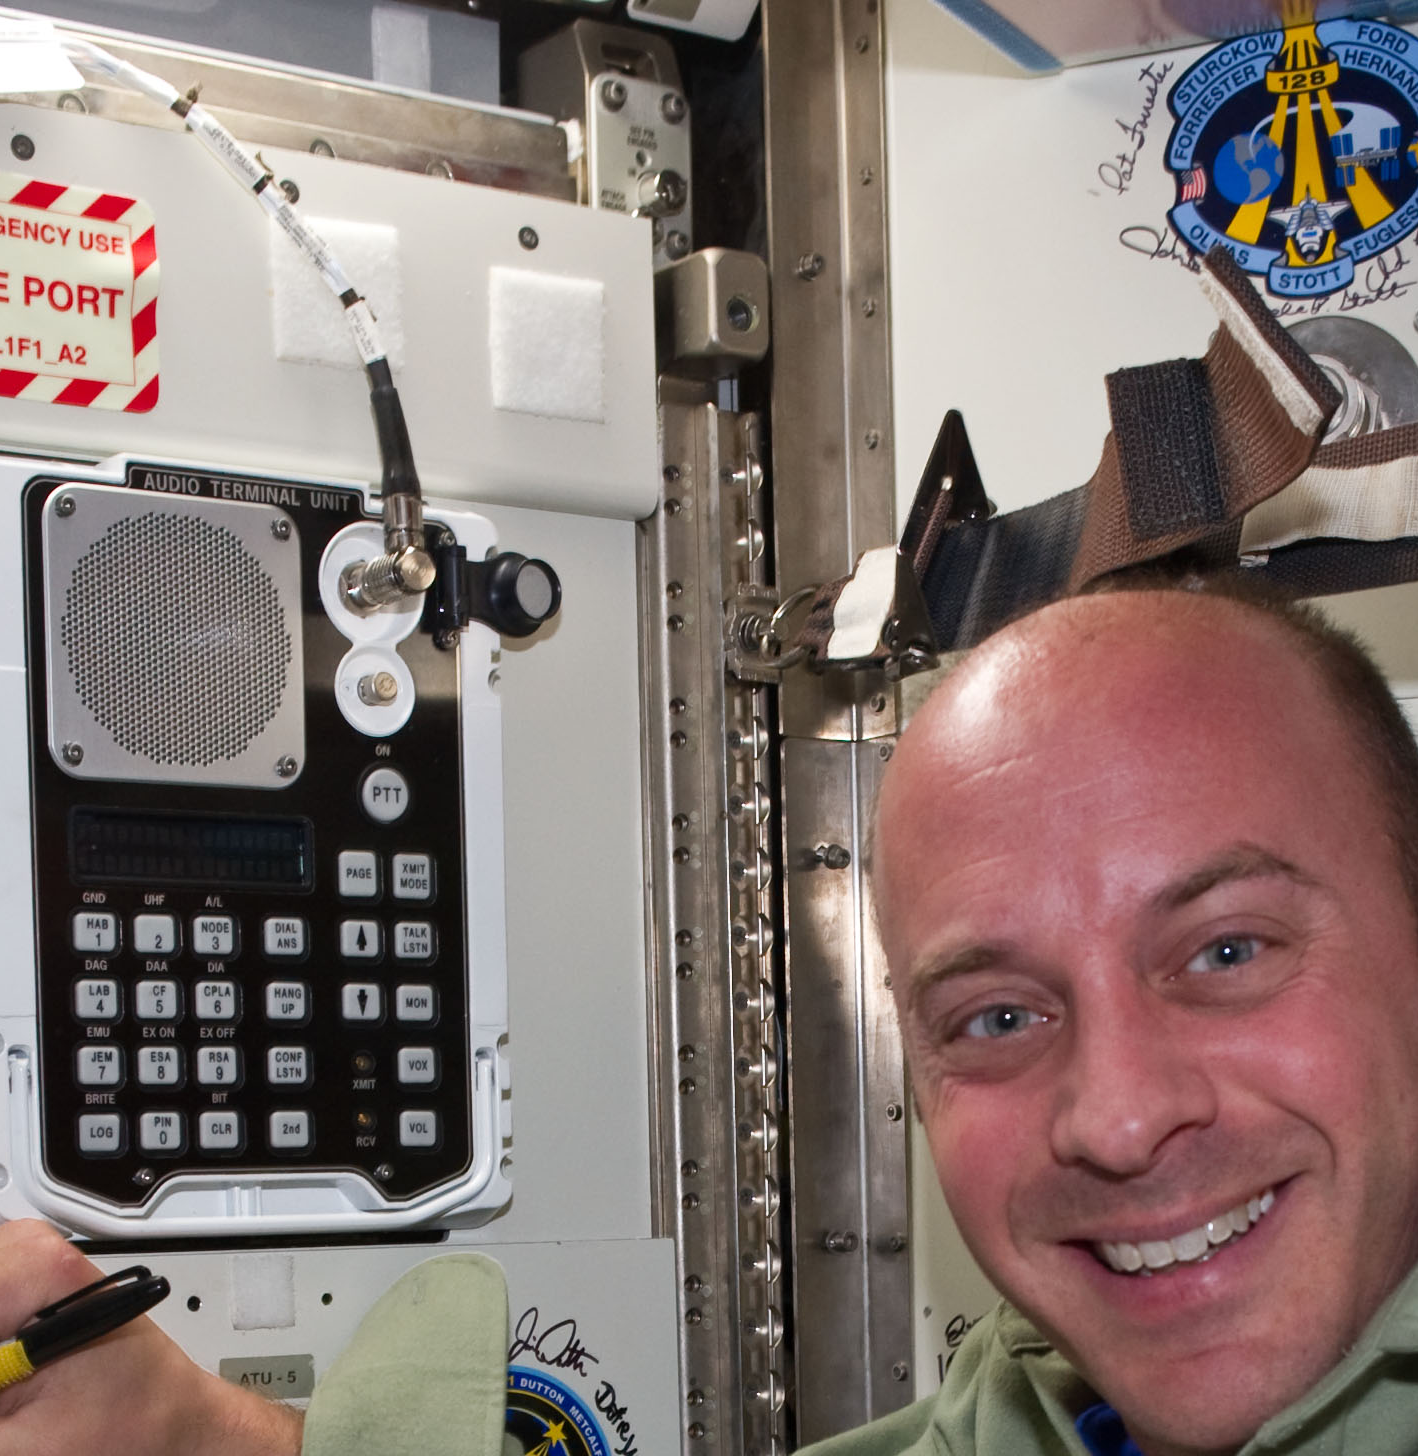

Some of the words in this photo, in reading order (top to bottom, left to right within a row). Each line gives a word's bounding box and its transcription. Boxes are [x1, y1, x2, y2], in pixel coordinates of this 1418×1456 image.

[1357, 25, 1408, 54] FORD
[1176, 34, 1278, 105] STURCKOW
[1279, 70, 1326, 90] 128
[1174, 64, 1258, 161] FORRESTER
[79, 230, 123, 253] USE
[1190, 224, 1249, 266] OLIAS
[1279, 265, 1340, 289] STOTT
[24, 276, 124, 319] PORT
[144, 473, 199, 494] AUDIO
[210, 480, 300, 506] TERMINAL
[310, 491, 350, 511] UNIT
[373, 786, 402, 803] PTT
[346, 868, 372, 879] PAGE
[402, 863, 425, 874] XMIT
[400, 878, 428, 890] MODE
[82, 892, 106, 904] GND
[144, 894, 165, 905] UHF
[205, 896, 223, 907] A/L
[87, 918, 109, 930] HAB
[201, 922, 229, 933] NODE
[275, 922, 297, 934] DIAL
[403, 927, 427, 938] TALK
[277, 938, 297, 949] ANS
[403, 942, 428, 953] LSTN
[85, 959, 107, 970] DAG
[146, 961, 168, 971] DAA
[208, 961, 224, 973] DIA
[89, 985, 110, 996] LAB
[204, 985, 231, 997] CPLA
[274, 988, 302, 999] HANG
[406, 997, 427, 1008] MON
[87, 1026, 110, 1037] EMU
[91, 1051, 113, 1063] JEM
[150, 1051, 171, 1063] ESA
[209, 1052, 229, 1063] RSA
[275, 1051, 302, 1063] CONF
[409, 1060, 428, 1071] VOX
[276, 1067, 302, 1078] LSTN
[85, 1093, 115, 1104] BRITE
[212, 1092, 228, 1103] BIT
[154, 1116, 172, 1127] PIN
[90, 1126, 113, 1138] LOG
[211, 1123, 232, 1135] CLR
[283, 1123, 300, 1135] 2nd
[409, 1122, 428, 1134] VOL
[240, 1372, 272, 1386] ATU
[287, 1370, 296, 1384] 5
[520, 1378, 565, 1404] DUTTON
